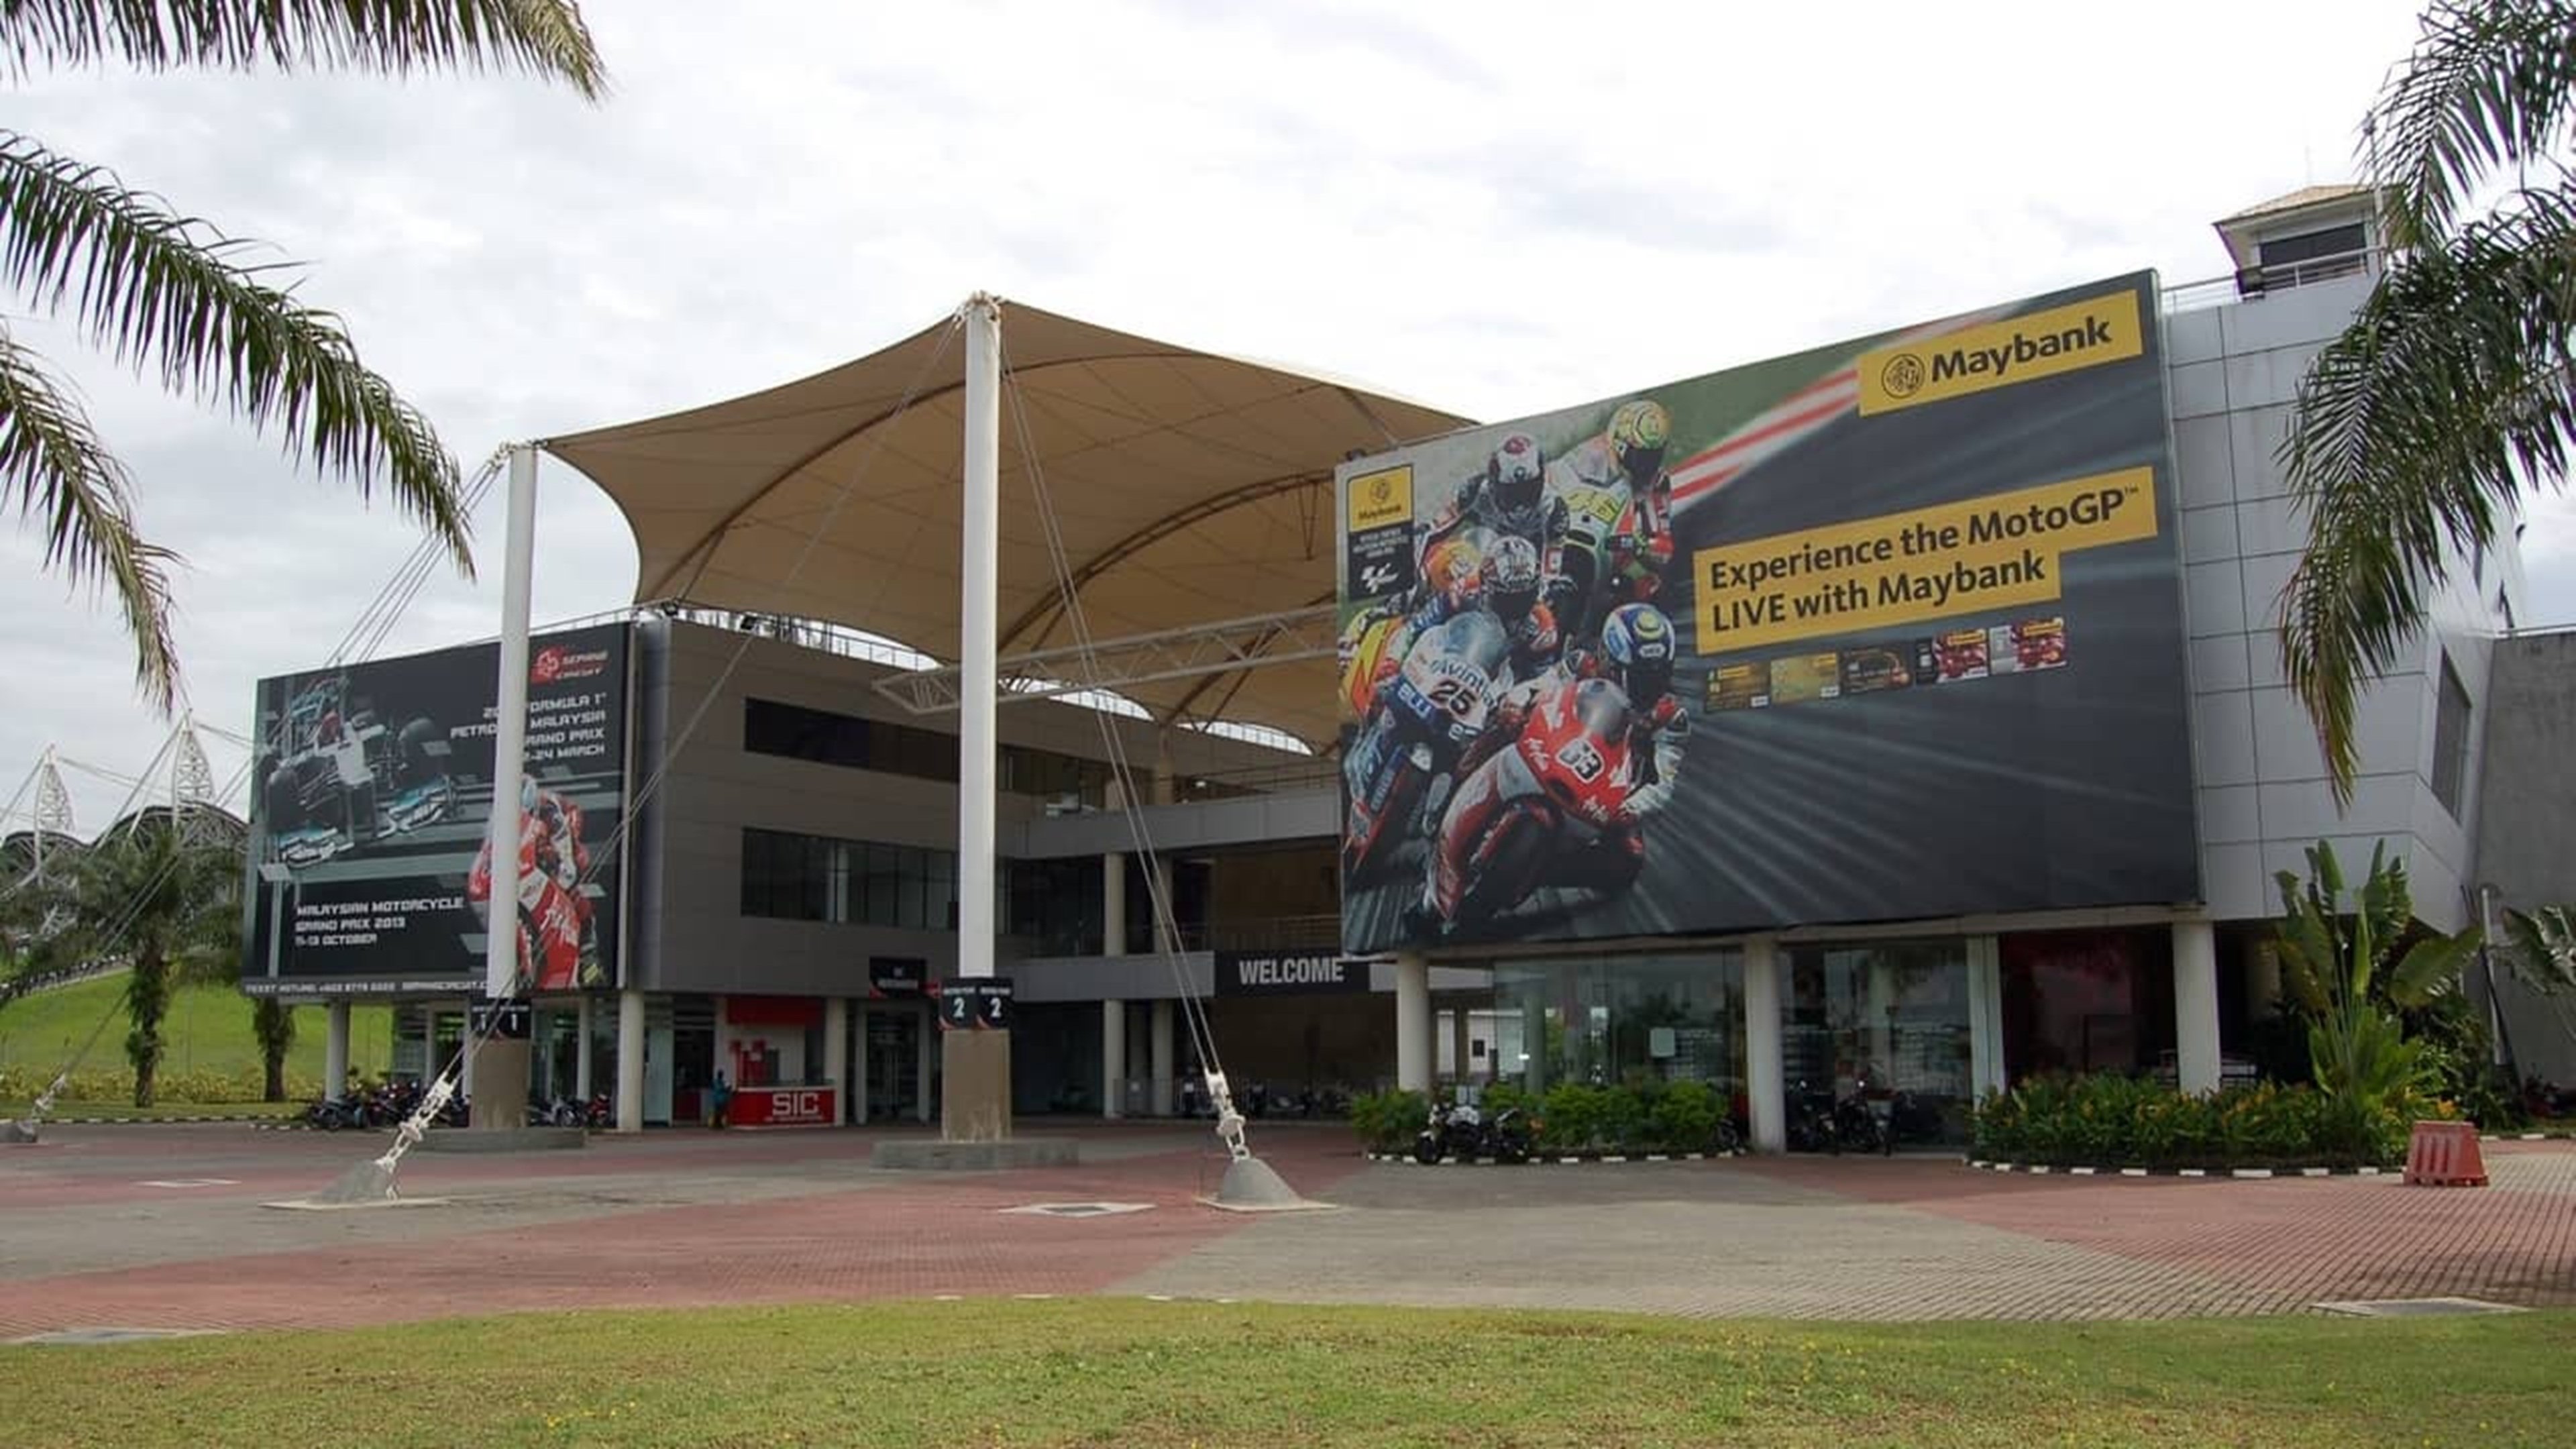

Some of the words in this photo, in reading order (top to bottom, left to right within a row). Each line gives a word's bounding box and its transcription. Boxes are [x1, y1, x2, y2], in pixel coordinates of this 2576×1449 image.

[1932, 316, 2112, 382] Maybank
[1711, 543, 1892, 591] Experience
[1900, 523, 1959, 557] the
[1713, 594, 1786, 632] LIVE
[1794, 580, 1869, 616] with
[1878, 549, 2045, 606] Maybank
[530, 695, 590, 713] ORMULA
[1428, 680, 1476, 715] 25
[526, 731, 565, 747] RAND
[569, 727, 605, 742] PRIX
[557, 744, 605, 759] MARCH
[297, 903, 369, 916] MALAYSIAN
[371, 897, 464, 912] MOTORCYCLE
[295, 920, 337, 932] GRAND
[340, 918, 370, 930] PRIX
[322, 933, 378, 945] OCTOBER
[1239, 957, 1344, 985] WELCOME
[953, 997, 965, 1018] 2
[990, 997, 1002, 1018] 2
[511, 1013, 518, 1031] 1
[772, 1092, 819, 1116] SIC
